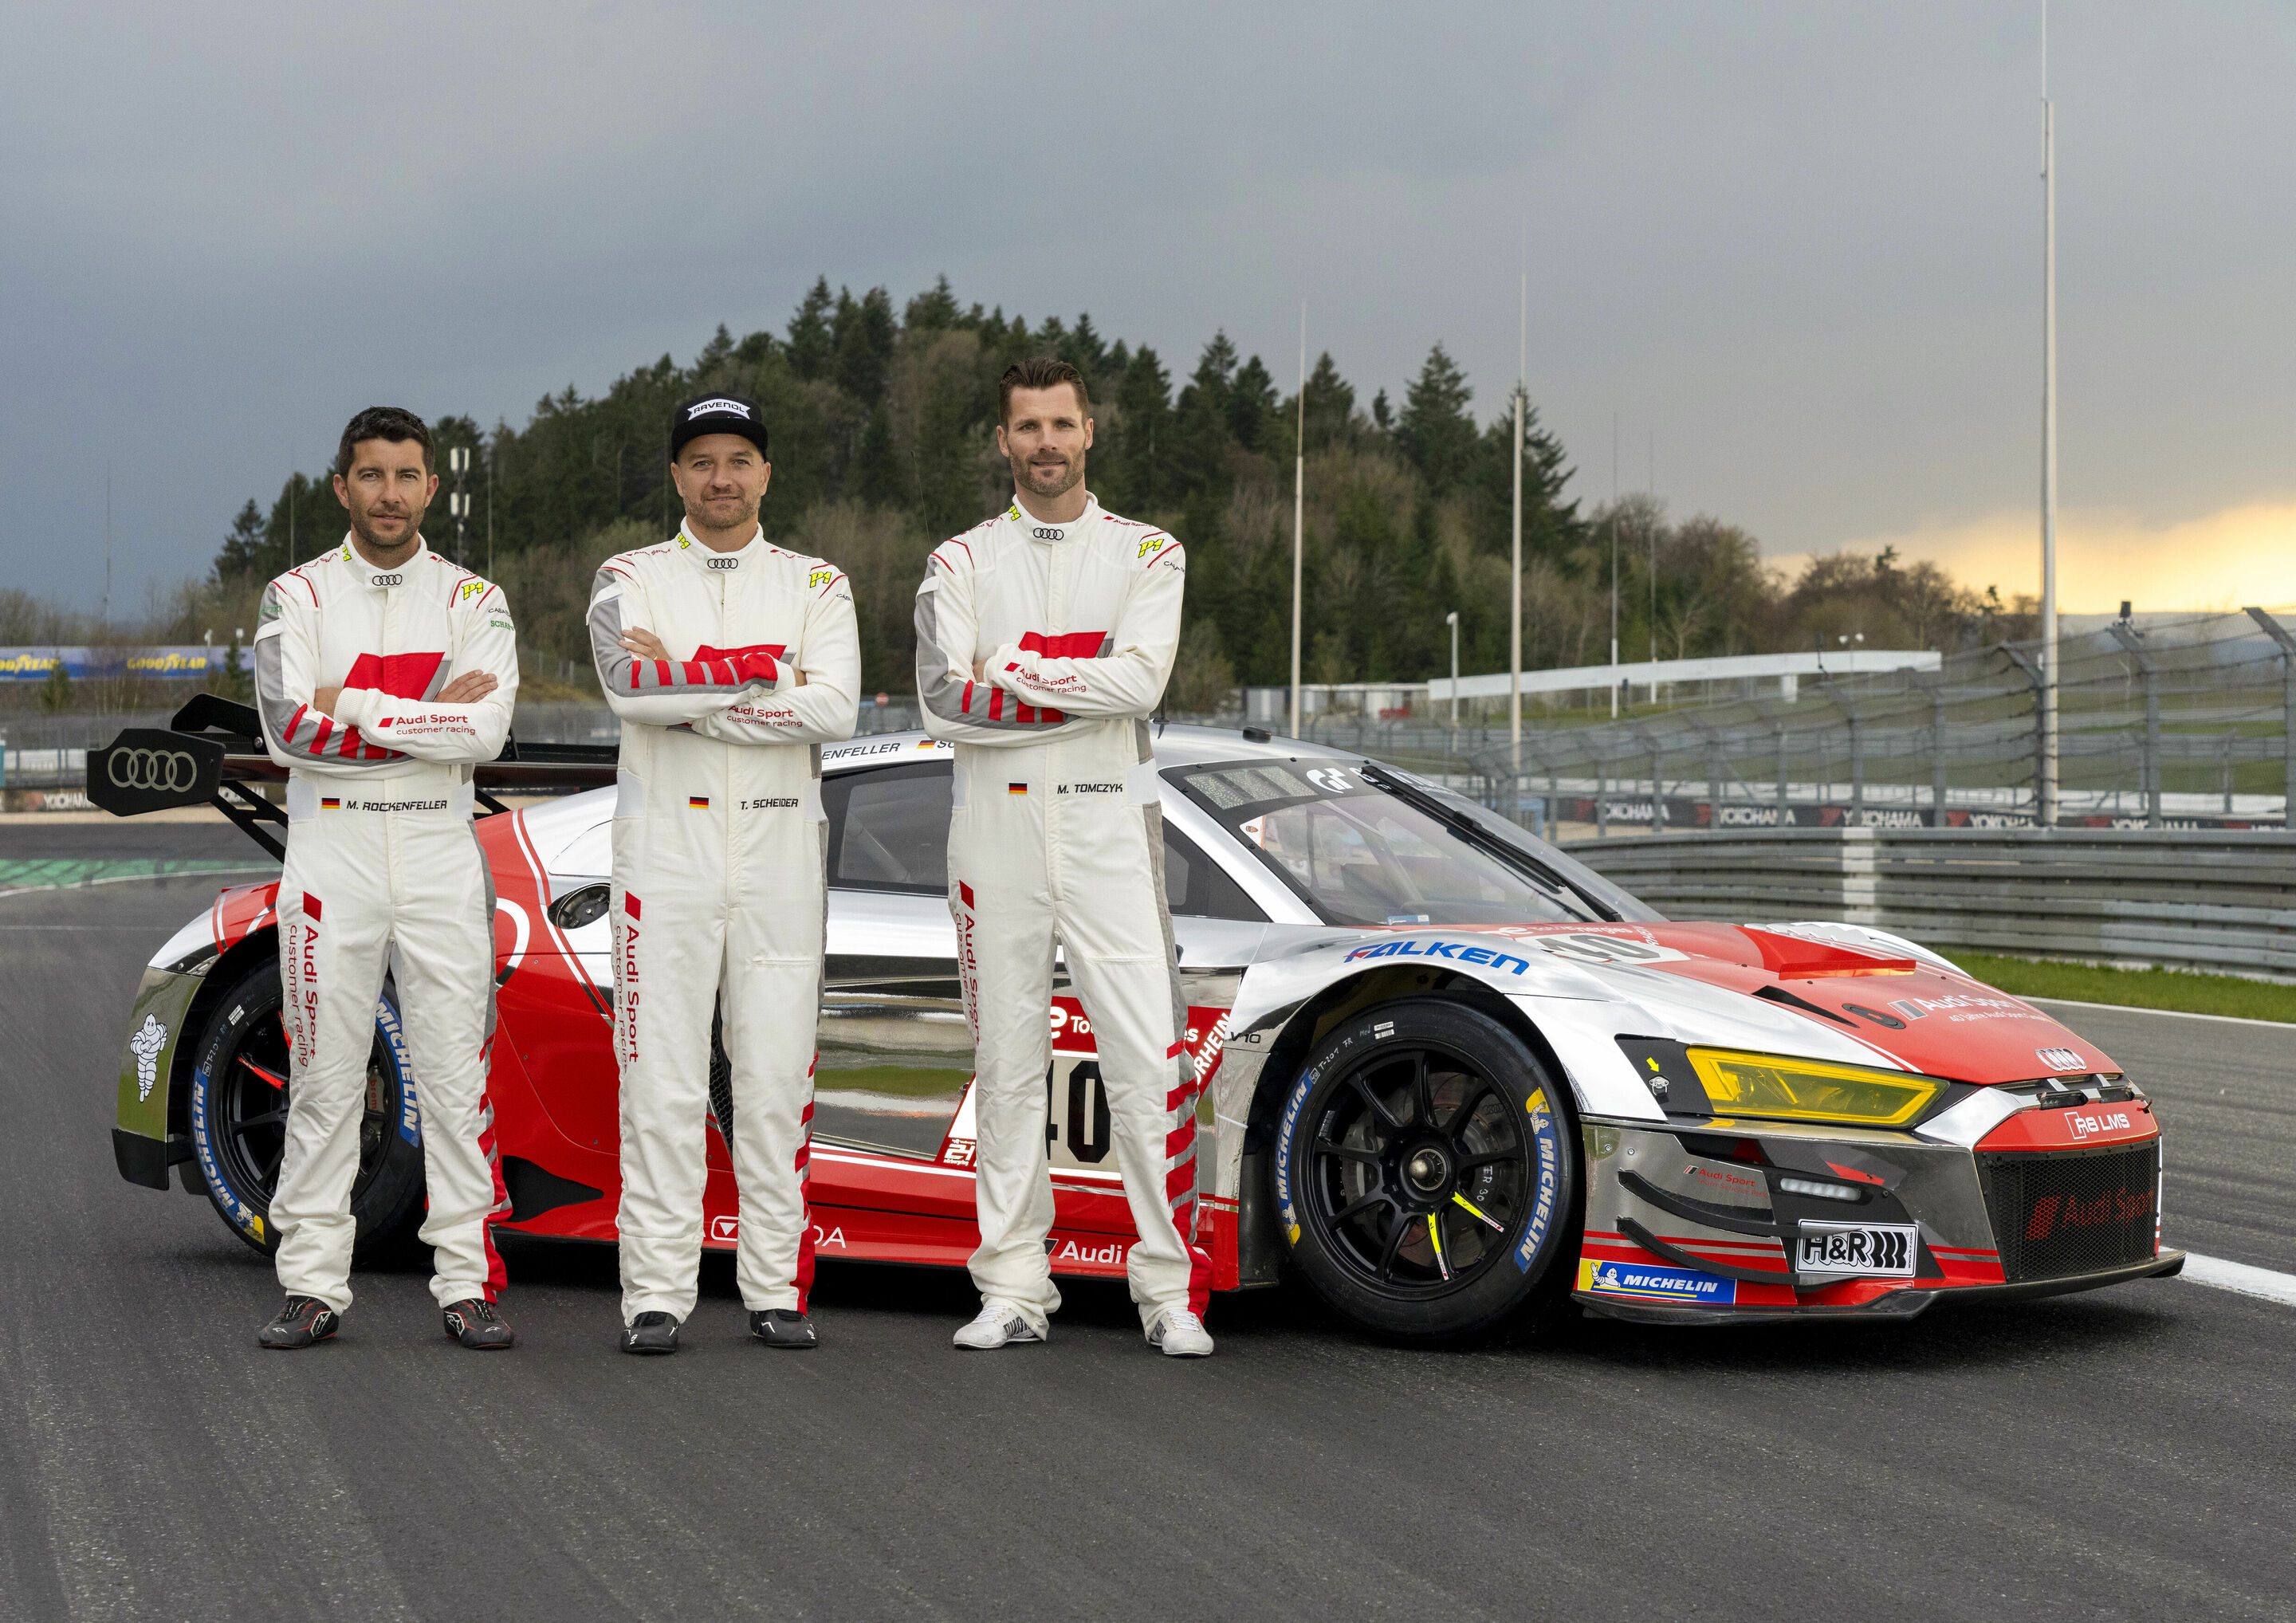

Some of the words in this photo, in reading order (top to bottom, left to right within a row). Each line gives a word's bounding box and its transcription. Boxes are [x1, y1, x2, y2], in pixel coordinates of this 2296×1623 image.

[694, 403, 745, 414] RAVENOL
[1138, 539, 1165, 558] P1
[808, 572, 832, 588] P1
[462, 582, 483, 600] P1
[127, 654, 206, 672] GOODYEAR
[1020, 668, 1040, 682] Audi
[1016, 677, 1054, 693] customer
[396, 714, 426, 725] Audi
[431, 714, 468, 726] Sport
[727, 715, 770, 726] customer
[728, 705, 754, 715] Audi
[757, 709, 794, 719] Sport
[396, 726, 443, 735] customer
[446, 725, 476, 735] racing
[822, 743, 901, 760] ENFELLER
[1057, 785, 1069, 794] M.
[1074, 784, 1122, 793] TOMCZYK
[347, 800, 359, 809] M.
[362, 800, 447, 812] ROCKENFELLER
[741, 800, 748, 809] T.
[753, 798, 798, 808] SCHEIDER
[1842, 810, 1923, 827] YKOHAMA
[965, 914, 977, 971] Audi
[304, 925, 319, 983] Audi
[627, 925, 639, 983] Audi
[1343, 941, 1530, 977] FALKEN
[288, 925, 300, 1008] customer
[296, 1016, 309, 1068] racing
[305, 989, 318, 1059] Sport
[626, 991, 639, 1063] Sport
[1230, 1032, 1261, 1044] V10
[376, 1002, 418, 1131] MICHELIN
[2074, 1117, 2099, 1134] R8
[2097, 1113, 2130, 1131] LMS
[194, 1083, 236, 1208] MICHELIN
[1276, 1082, 1307, 1201] MICHELIN
[1697, 1177, 1718, 1188] Team
[1698, 1169, 1723, 1180] Audi
[1725, 1174, 1756, 1187] Sport
[1520, 1137, 1555, 1262] MICHELIN
[1058, 1240, 1122, 1264] Audi
[1803, 1230, 1871, 1265] H&R
[1623, 1274, 1718, 1293] MICHELIN
